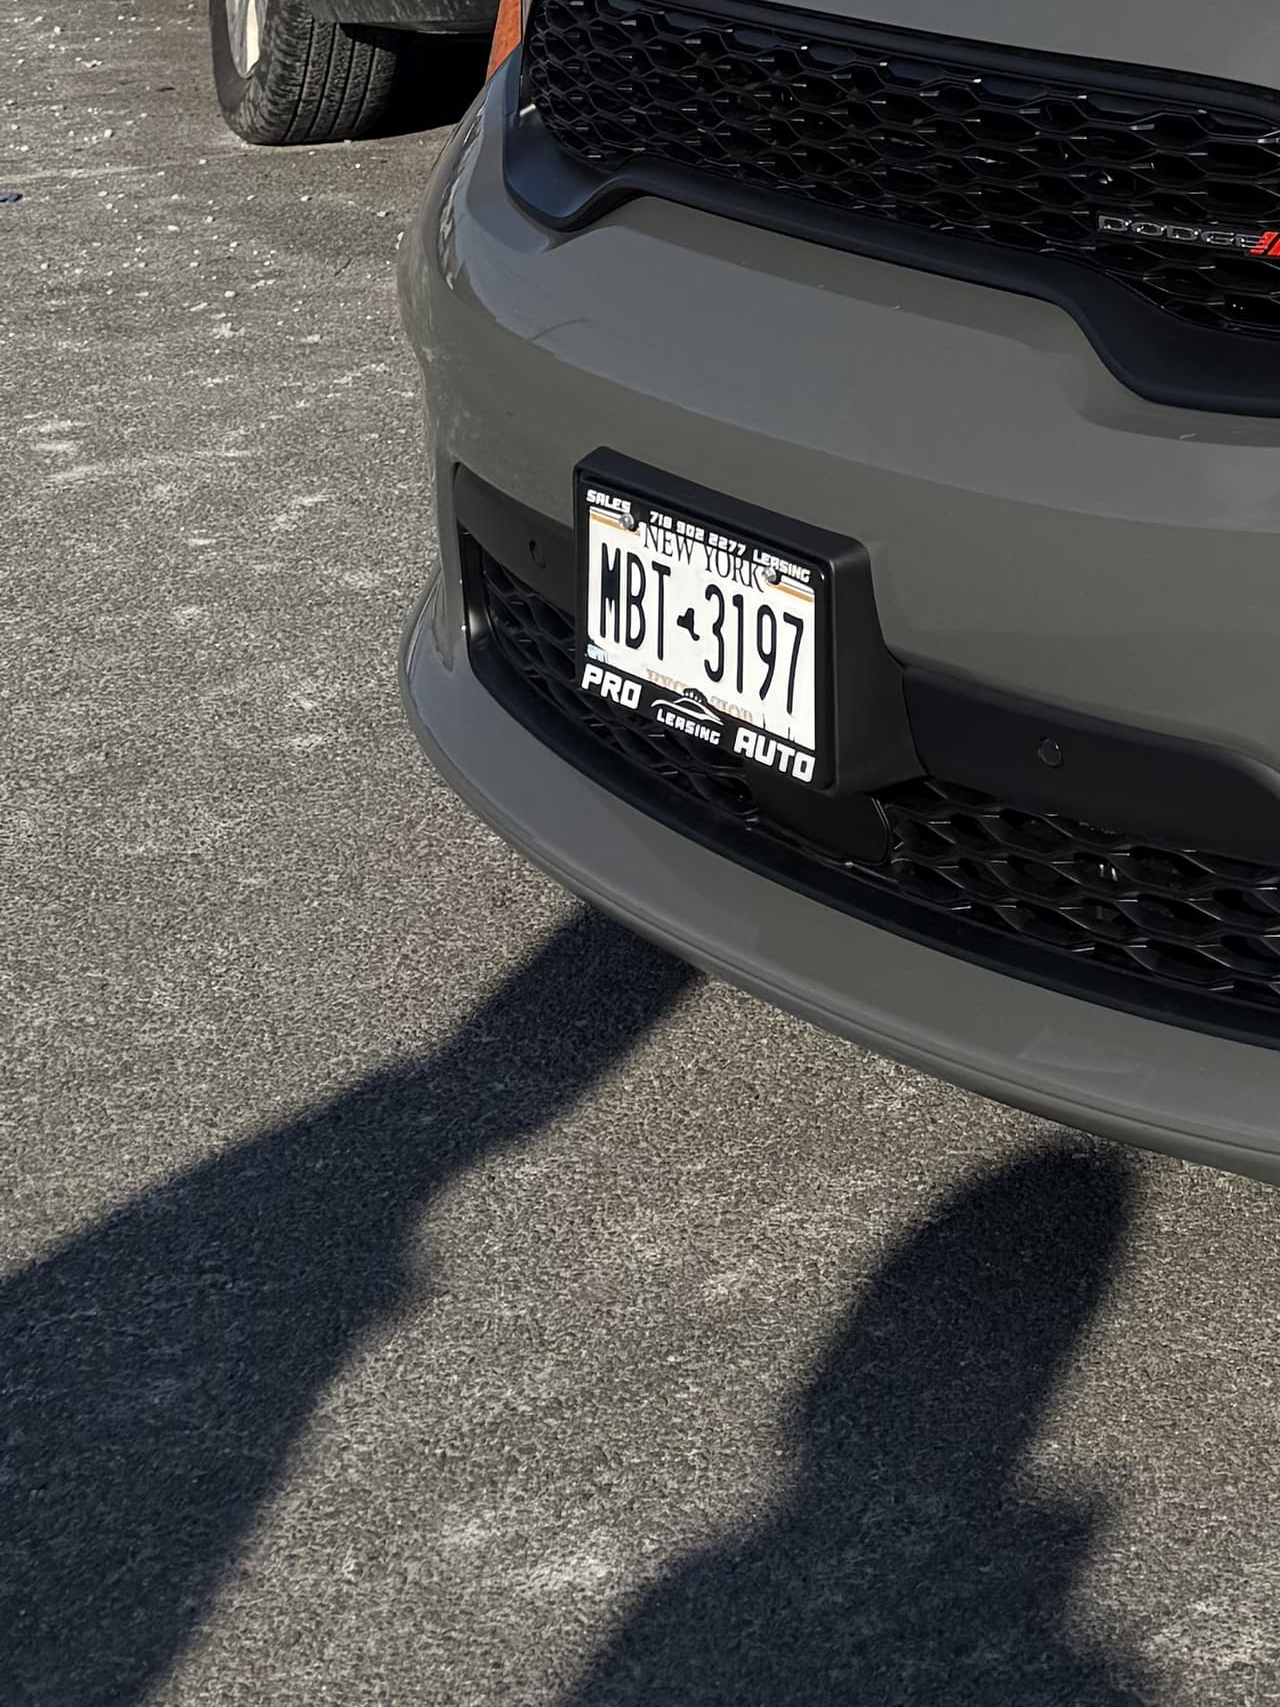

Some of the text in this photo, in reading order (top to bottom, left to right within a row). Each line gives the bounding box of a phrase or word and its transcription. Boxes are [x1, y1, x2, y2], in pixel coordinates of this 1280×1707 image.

[1097, 214, 1268, 250] DODGE
[586, 488, 632, 514] SALES
[649, 510, 747, 555] 718 902 2277
[643, 525, 765, 593] NEW YORK
[752, 548, 812, 584] LEASING
[600, 541, 672, 662] MBT
[704, 584, 805, 720] 3197
[581, 665, 643, 711] PRO
[656, 709, 722, 746] LEASING
[733, 725, 816, 784] AUTO
